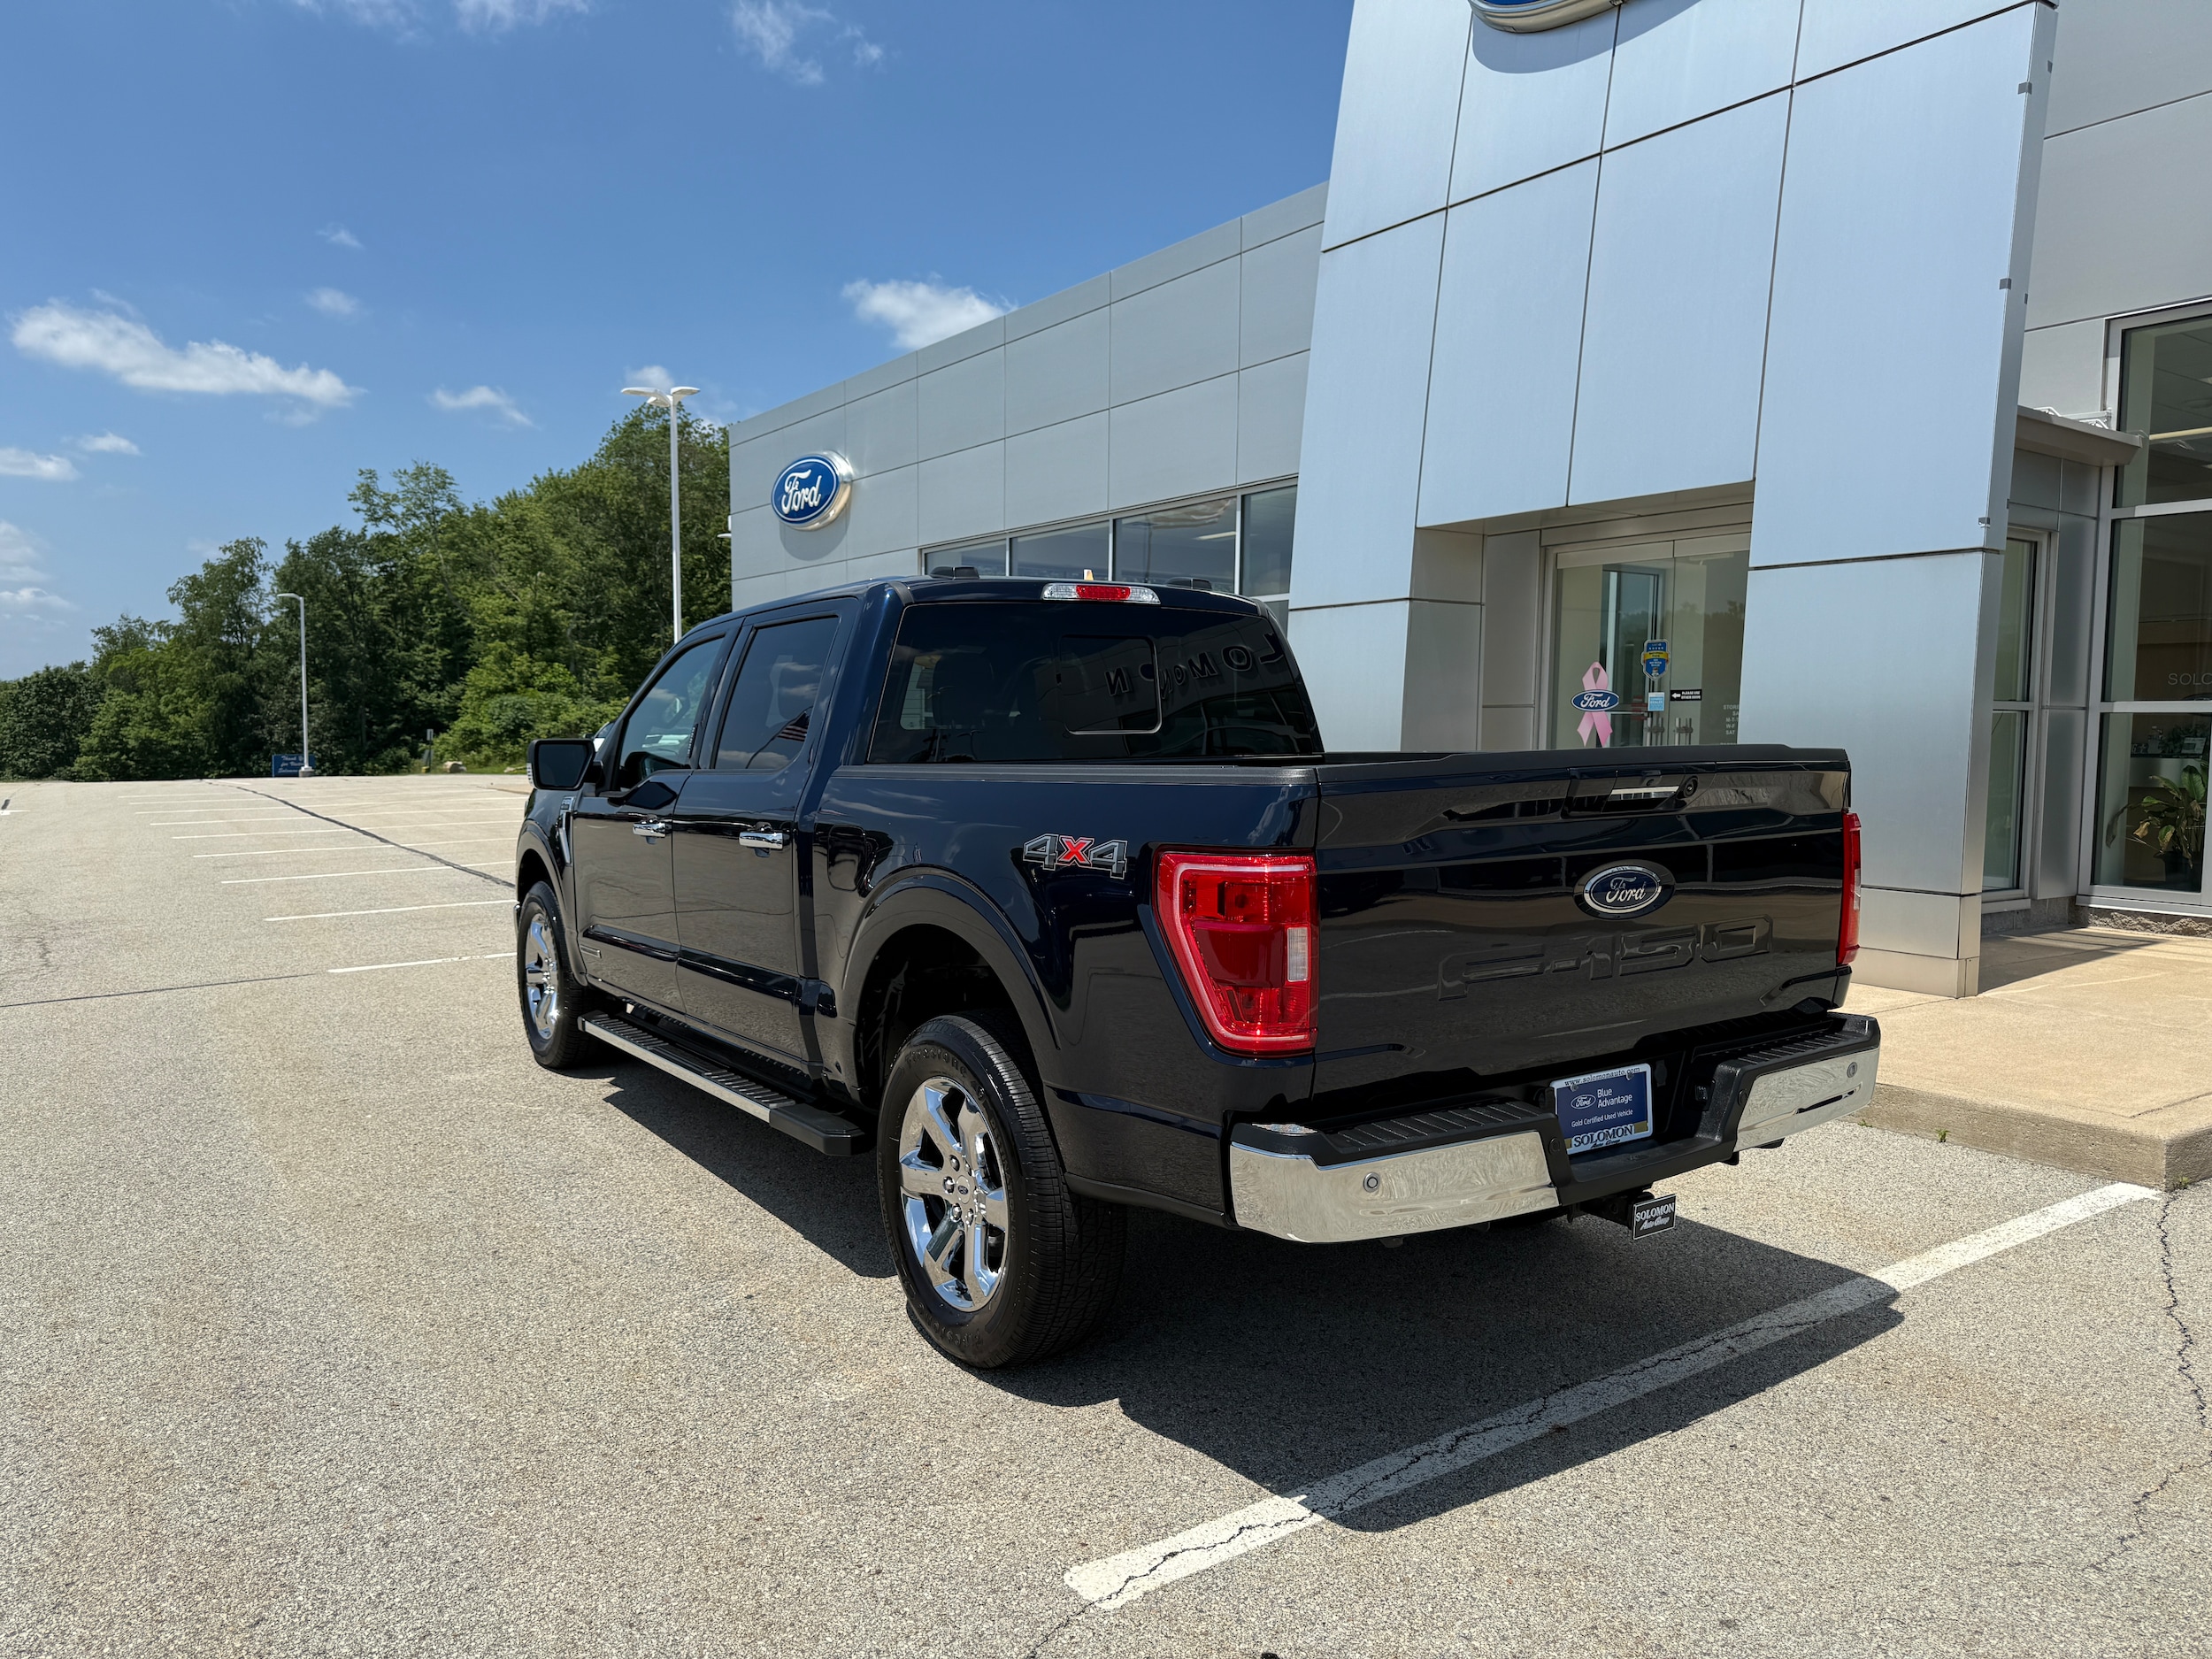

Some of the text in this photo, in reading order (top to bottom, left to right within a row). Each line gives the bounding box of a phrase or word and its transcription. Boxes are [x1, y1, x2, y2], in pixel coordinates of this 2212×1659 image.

[781, 469, 822, 514] Ford
[1580, 693, 1611, 708] Ford
[1606, 877, 1647, 903] Ford
[1564, 1067, 1640, 1086] www.solomonauto.com
[1576, 1096, 1591, 1107] Ford
[1597, 1088, 1612, 1098] Blue
[1597, 1094, 1633, 1109] Advantage
[1571, 1109, 1633, 1128] Gold Certified Used Vehicle
[1574, 1125, 1634, 1148] SOLOMON
[1635, 1202, 1675, 1222] SOLOMON
[1640, 1219, 1655, 1231] Auto
